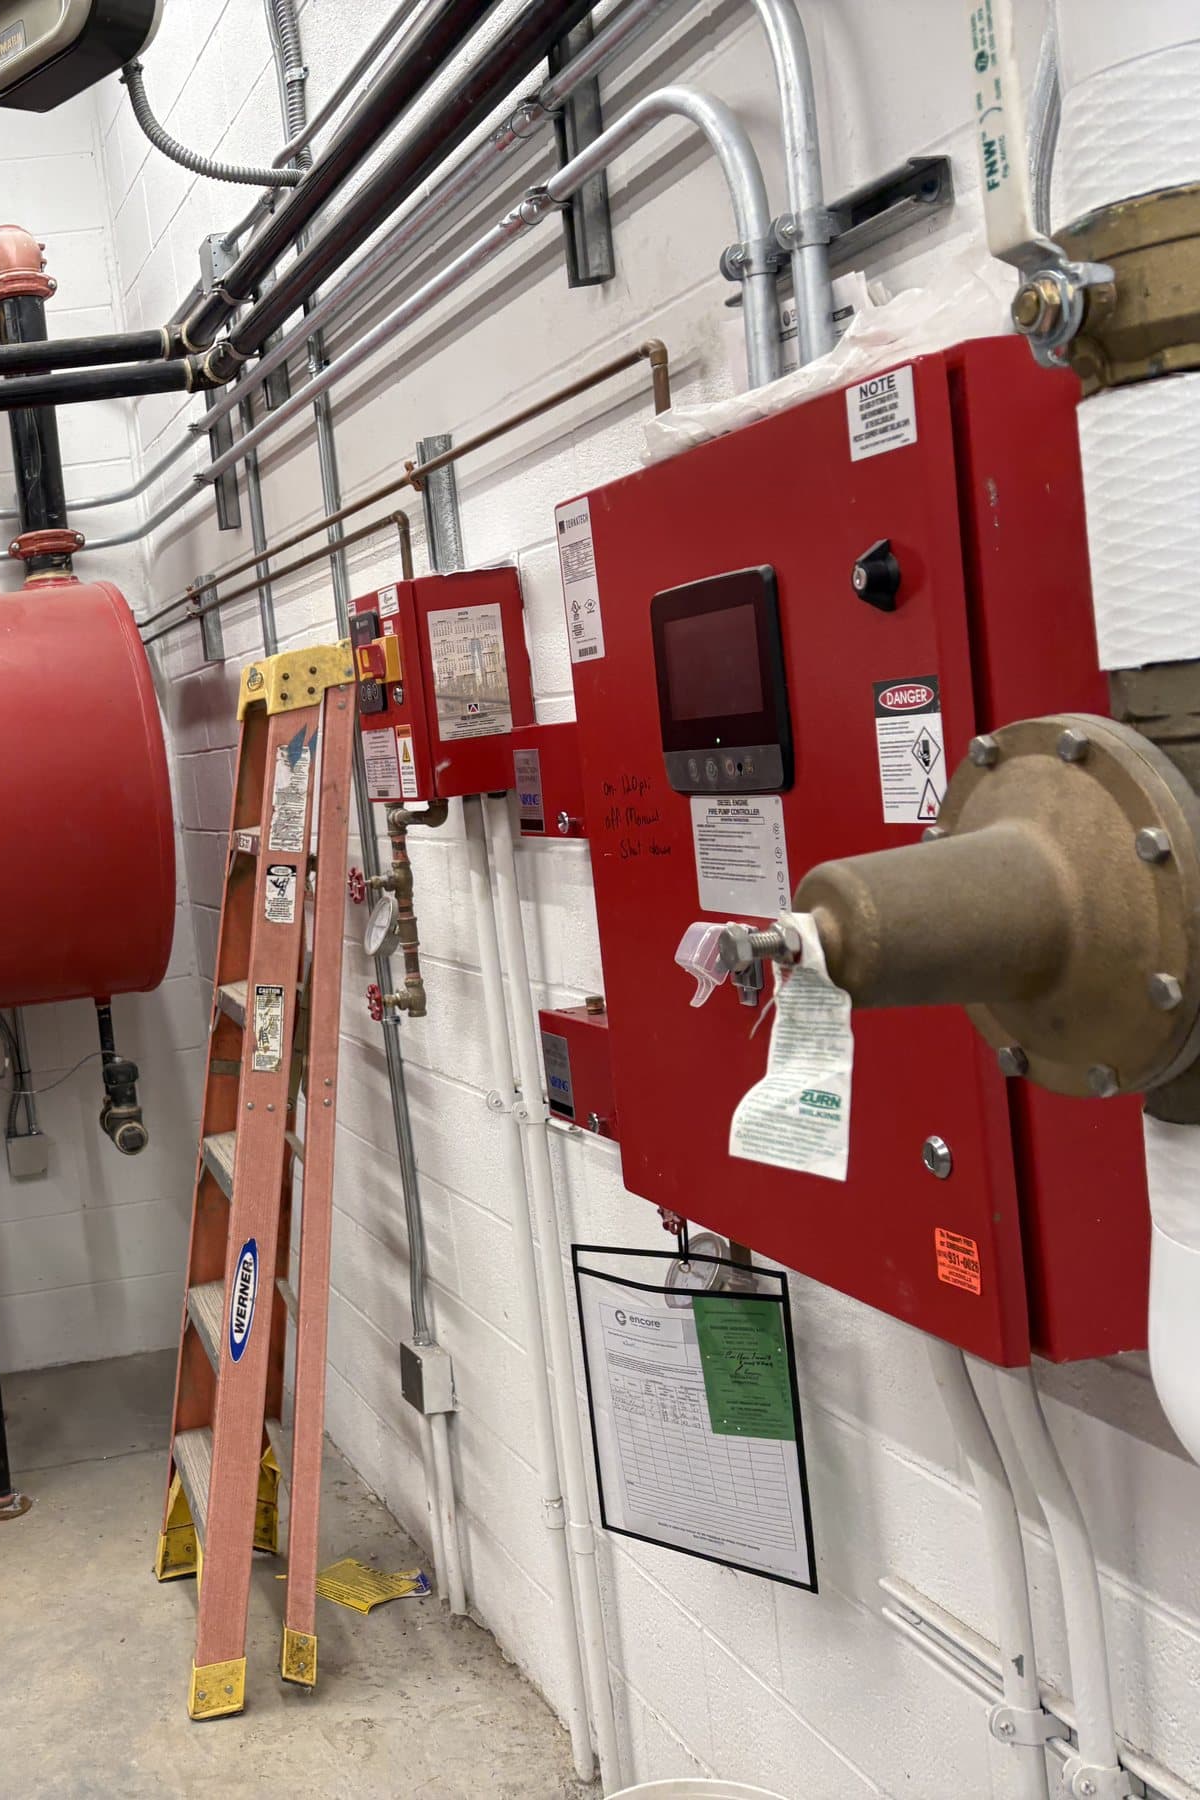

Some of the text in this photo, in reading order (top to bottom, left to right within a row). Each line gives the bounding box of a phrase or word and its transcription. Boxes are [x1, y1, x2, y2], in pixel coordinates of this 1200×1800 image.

[983, 140, 1000, 192] FNW
[859, 374, 896, 399] NOTE
[886, 688, 927, 705] DANGER
[730, 808, 760, 816] CONTROLLER
[799, 1090, 842, 1108] ZURN
[234, 1259, 253, 1334] WERNER
[629, 1315, 661, 1328] encore
